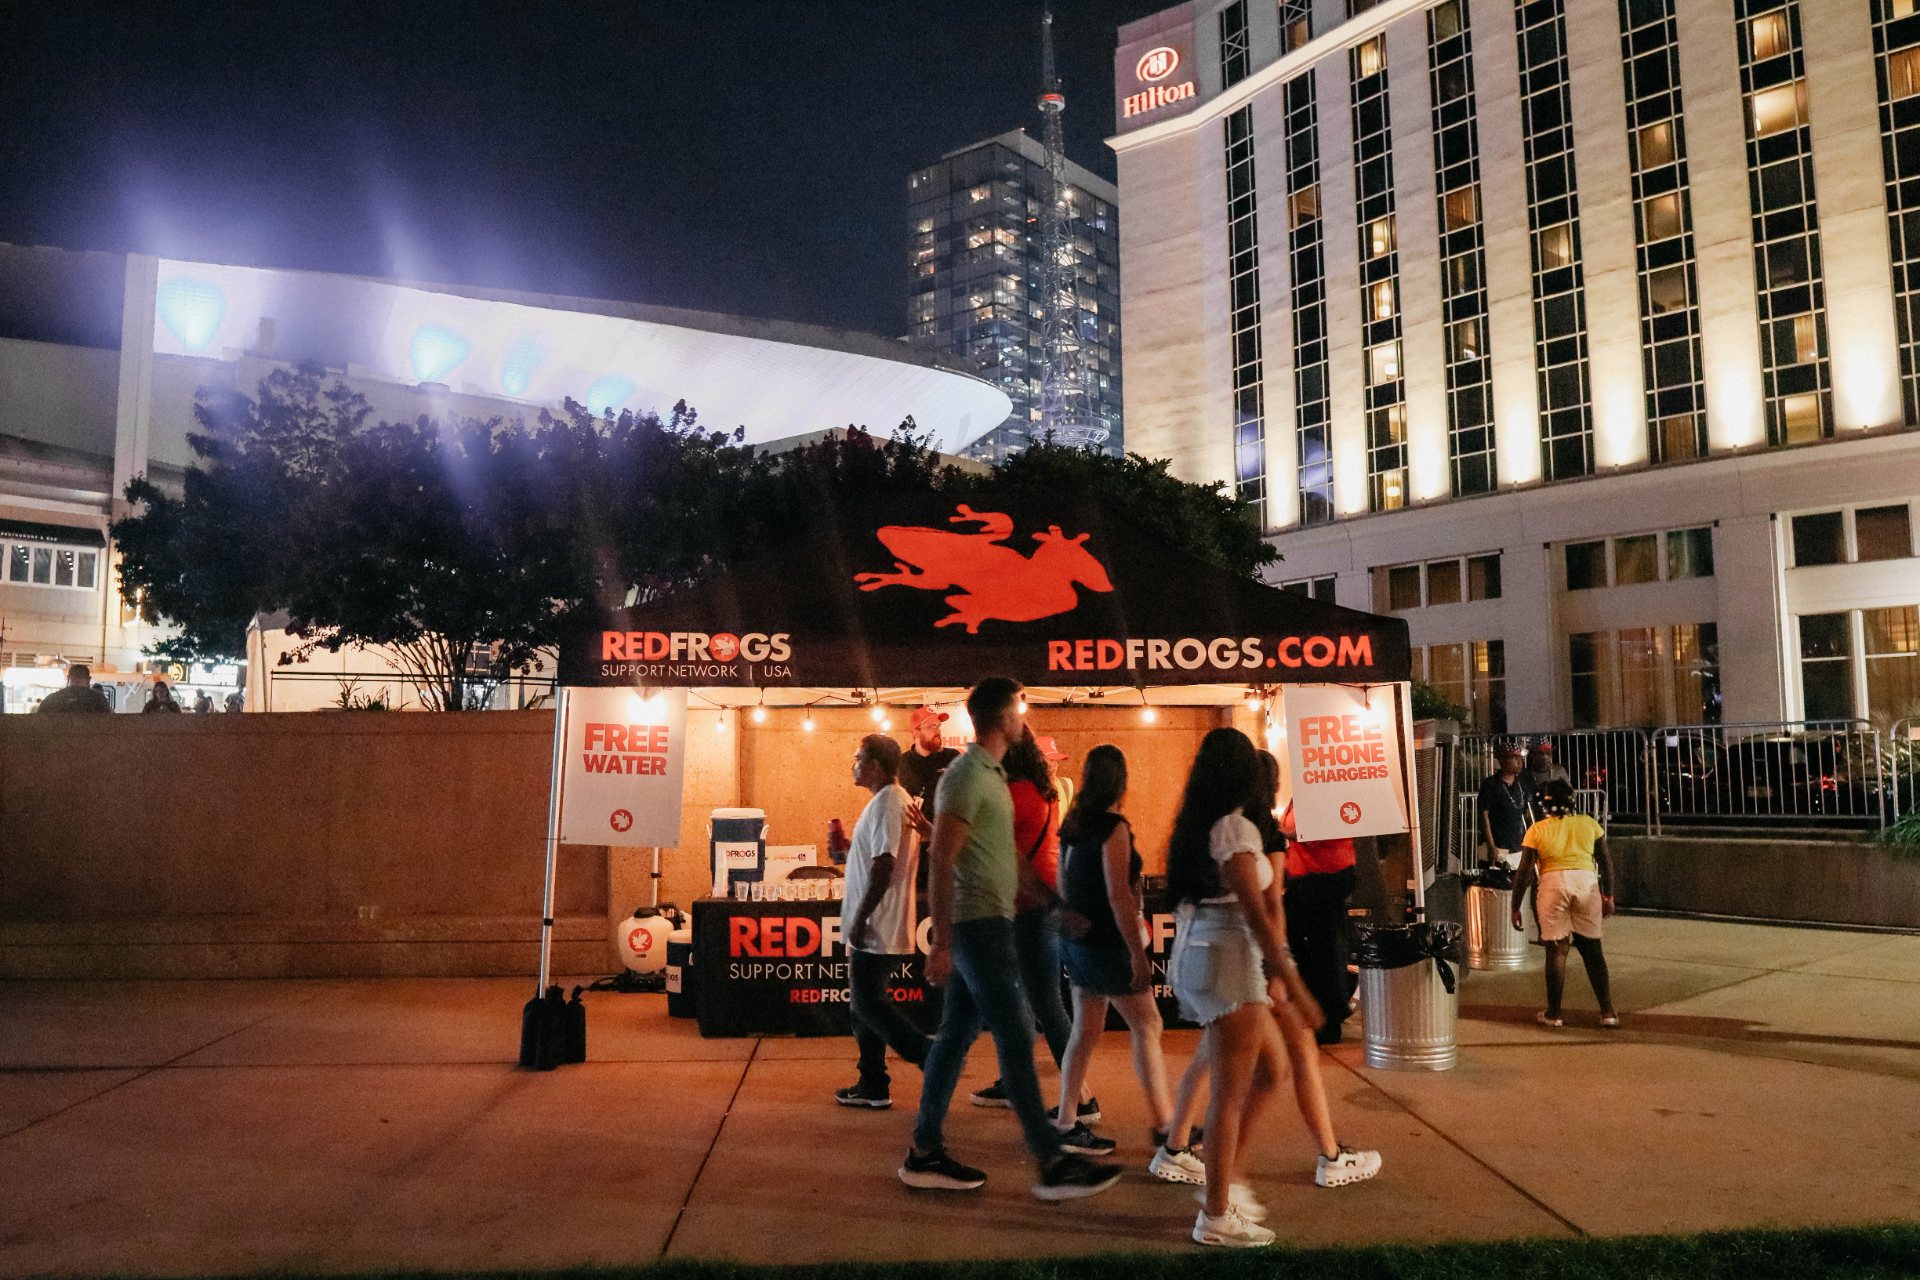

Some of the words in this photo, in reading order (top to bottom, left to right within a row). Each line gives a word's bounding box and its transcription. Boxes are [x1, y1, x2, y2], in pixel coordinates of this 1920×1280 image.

[1123, 81, 1196, 118] Hilton
[602, 632, 791, 661] REDFROGS
[1048, 635, 1374, 671] REDFROGS.COM
[601, 665, 664, 677] SUPPORT
[668, 665, 738, 678] NETWORK
[764, 666, 792, 678] USA
[584, 723, 669, 753] FREE
[1299, 714, 1382, 745] FREE
[583, 753, 667, 775] WATER
[1302, 742, 1386, 768] PHONE
[1303, 765, 1389, 784] CHARGERS
[725, 849, 756, 858] DFROGS
[729, 963, 813, 980] SUPPORT
[818, 963, 914, 980] NETK
[790, 988, 924, 1003] REDFROOM
